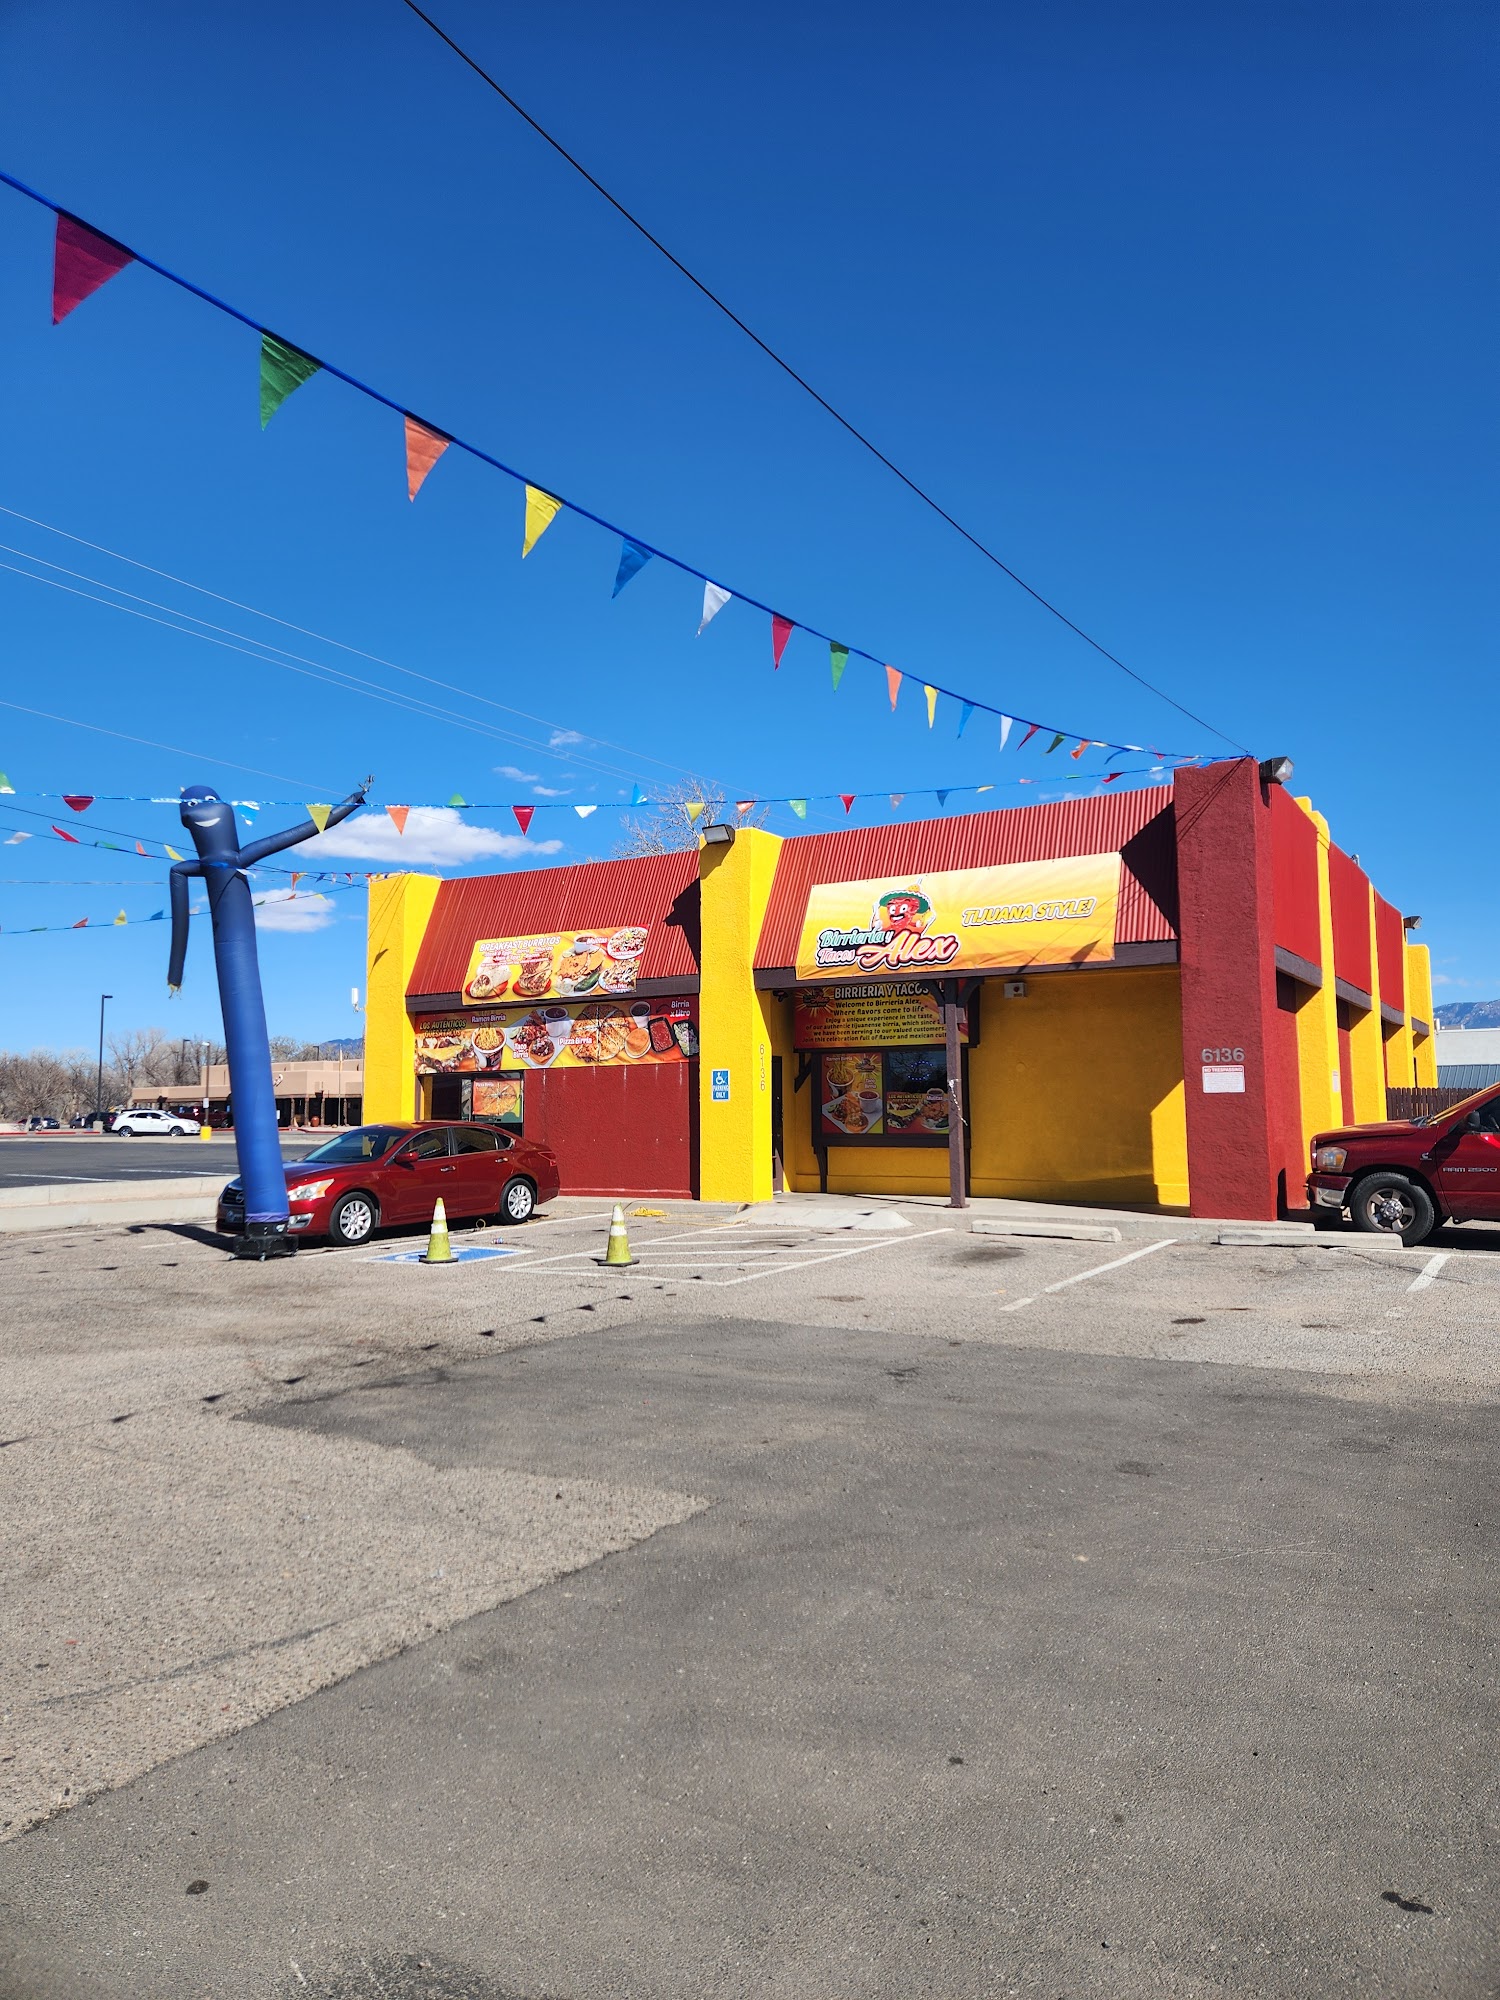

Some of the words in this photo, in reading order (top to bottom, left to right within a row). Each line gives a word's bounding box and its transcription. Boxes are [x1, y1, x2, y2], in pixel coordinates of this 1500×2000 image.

[962, 903, 1034, 925] TIJUANA
[1035, 898, 1095, 920] STYLE!
[885, 931, 894, 944] y
[479, 940, 522, 952] BREAKFAST
[523, 936, 561, 948] BURRITOS
[856, 929, 959, 968] Alex
[818, 947, 856, 964] Tacos
[834, 985, 885, 999] BIRRIERIA
[885, 983, 894, 996] Y
[671, 1000, 690, 1009] Birria
[472, 1015, 490, 1023] Ramen
[491, 1014, 506, 1022] Birria
[420, 1022, 430, 1030] LOS
[909, 1031, 934, 1039] mexican
[559, 1037, 574, 1045] Pizza
[513, 1050, 528, 1058] Birria
[1201, 1047, 1245, 1063] 6136
[715, 1091, 726, 1099] ONLY
